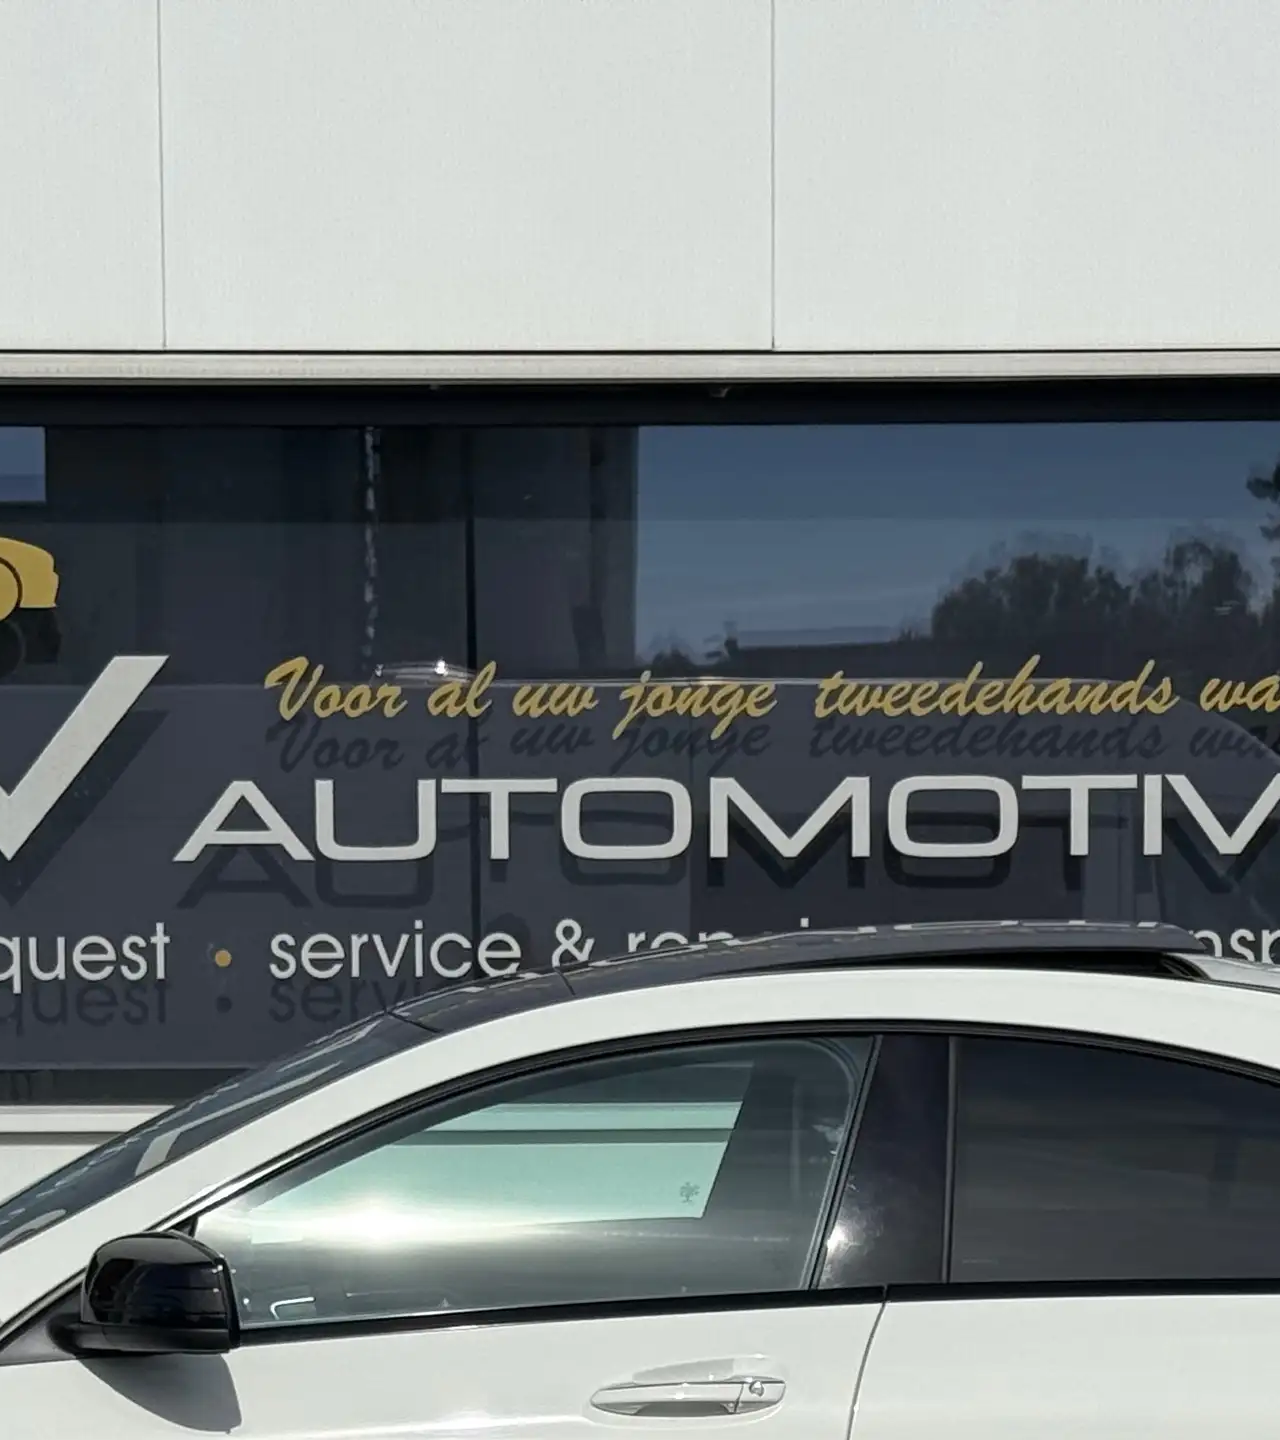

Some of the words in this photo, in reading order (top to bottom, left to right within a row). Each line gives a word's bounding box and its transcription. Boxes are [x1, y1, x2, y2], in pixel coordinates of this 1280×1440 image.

[265, 656, 409, 722] Voor
[427, 660, 497, 719] al
[511, 678, 599, 719] uw
[612, 670, 779, 740] jonge
[814, 654, 1180, 719] tweedehands
[268, 919, 521, 980] service
[551, 918, 595, 968] &
